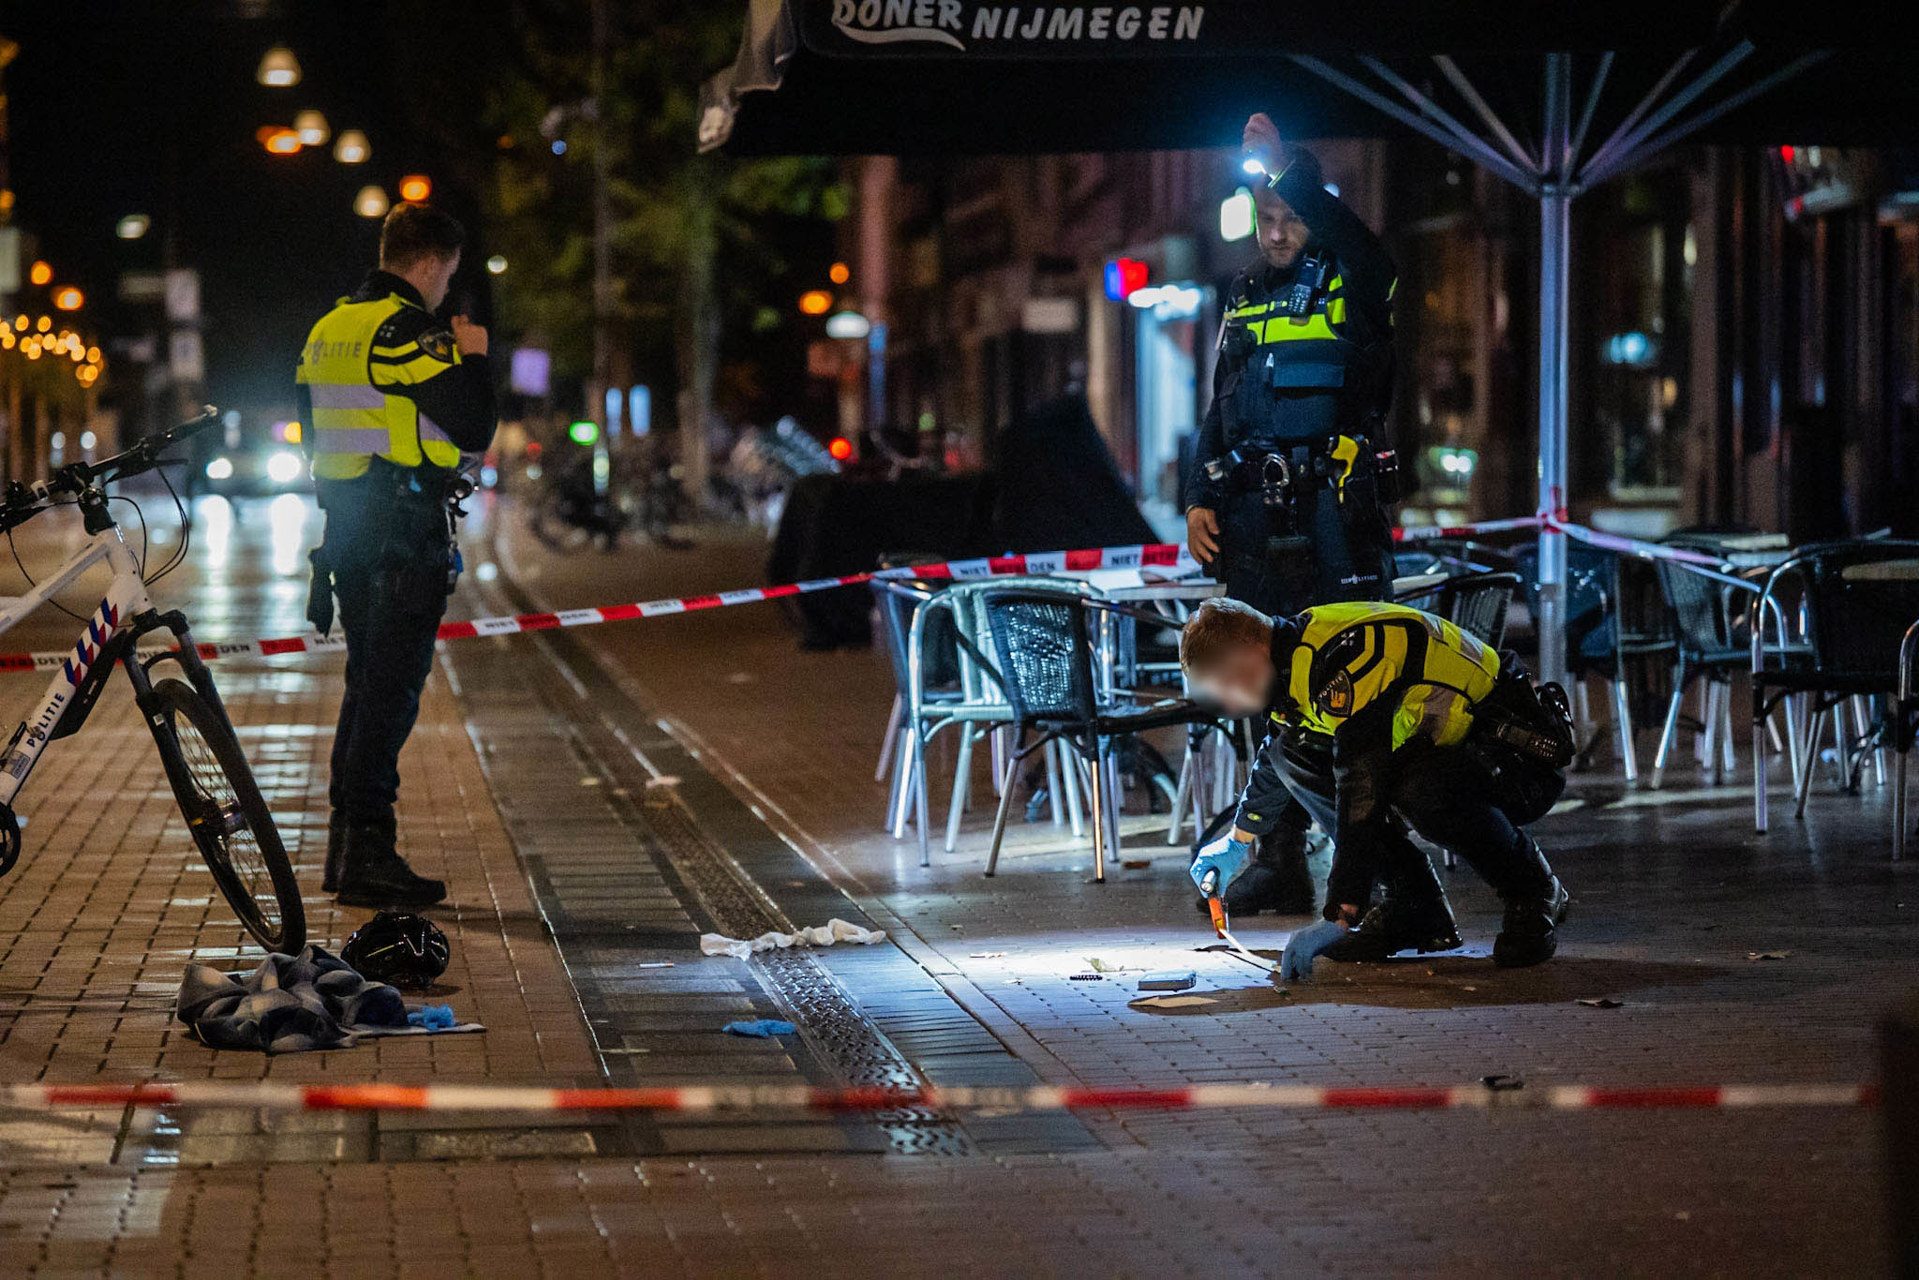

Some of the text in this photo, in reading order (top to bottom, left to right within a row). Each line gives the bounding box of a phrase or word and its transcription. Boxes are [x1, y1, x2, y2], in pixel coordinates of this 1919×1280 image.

[971, 6, 1204, 40] NIJMEGEN
[1111, 553, 1139, 566] NIET
[26, 692, 65, 748] POLITIE
